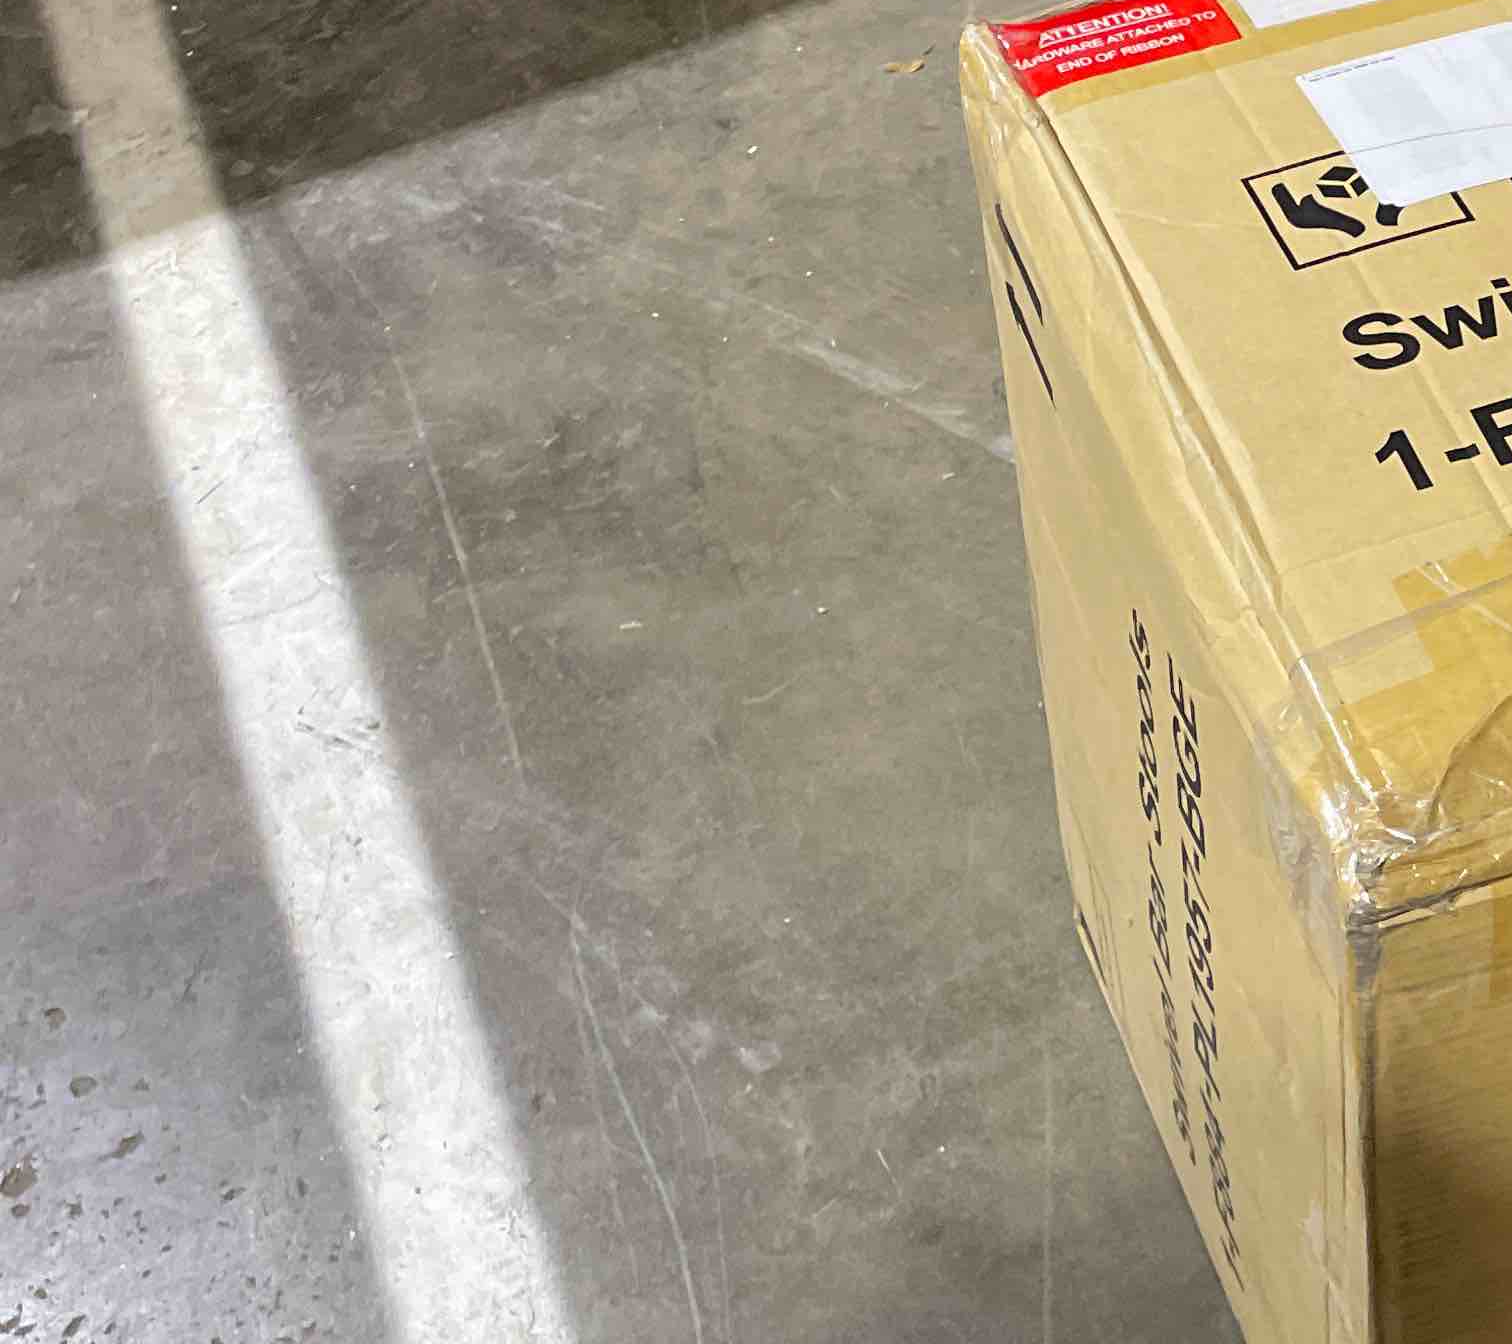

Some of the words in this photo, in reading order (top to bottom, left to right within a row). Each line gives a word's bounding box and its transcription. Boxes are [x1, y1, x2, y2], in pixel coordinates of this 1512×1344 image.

[1039, 3, 1169, 44] ATTENTION!
[1106, 16, 1191, 45] ATTACHED
[1192, 10, 1217, 23] TO
[1056, 55, 1093, 74] END
[1095, 50, 1119, 64] OF
[1120, 32, 1186, 58] RIBBON
[1128, 608, 1163, 847] Stools
